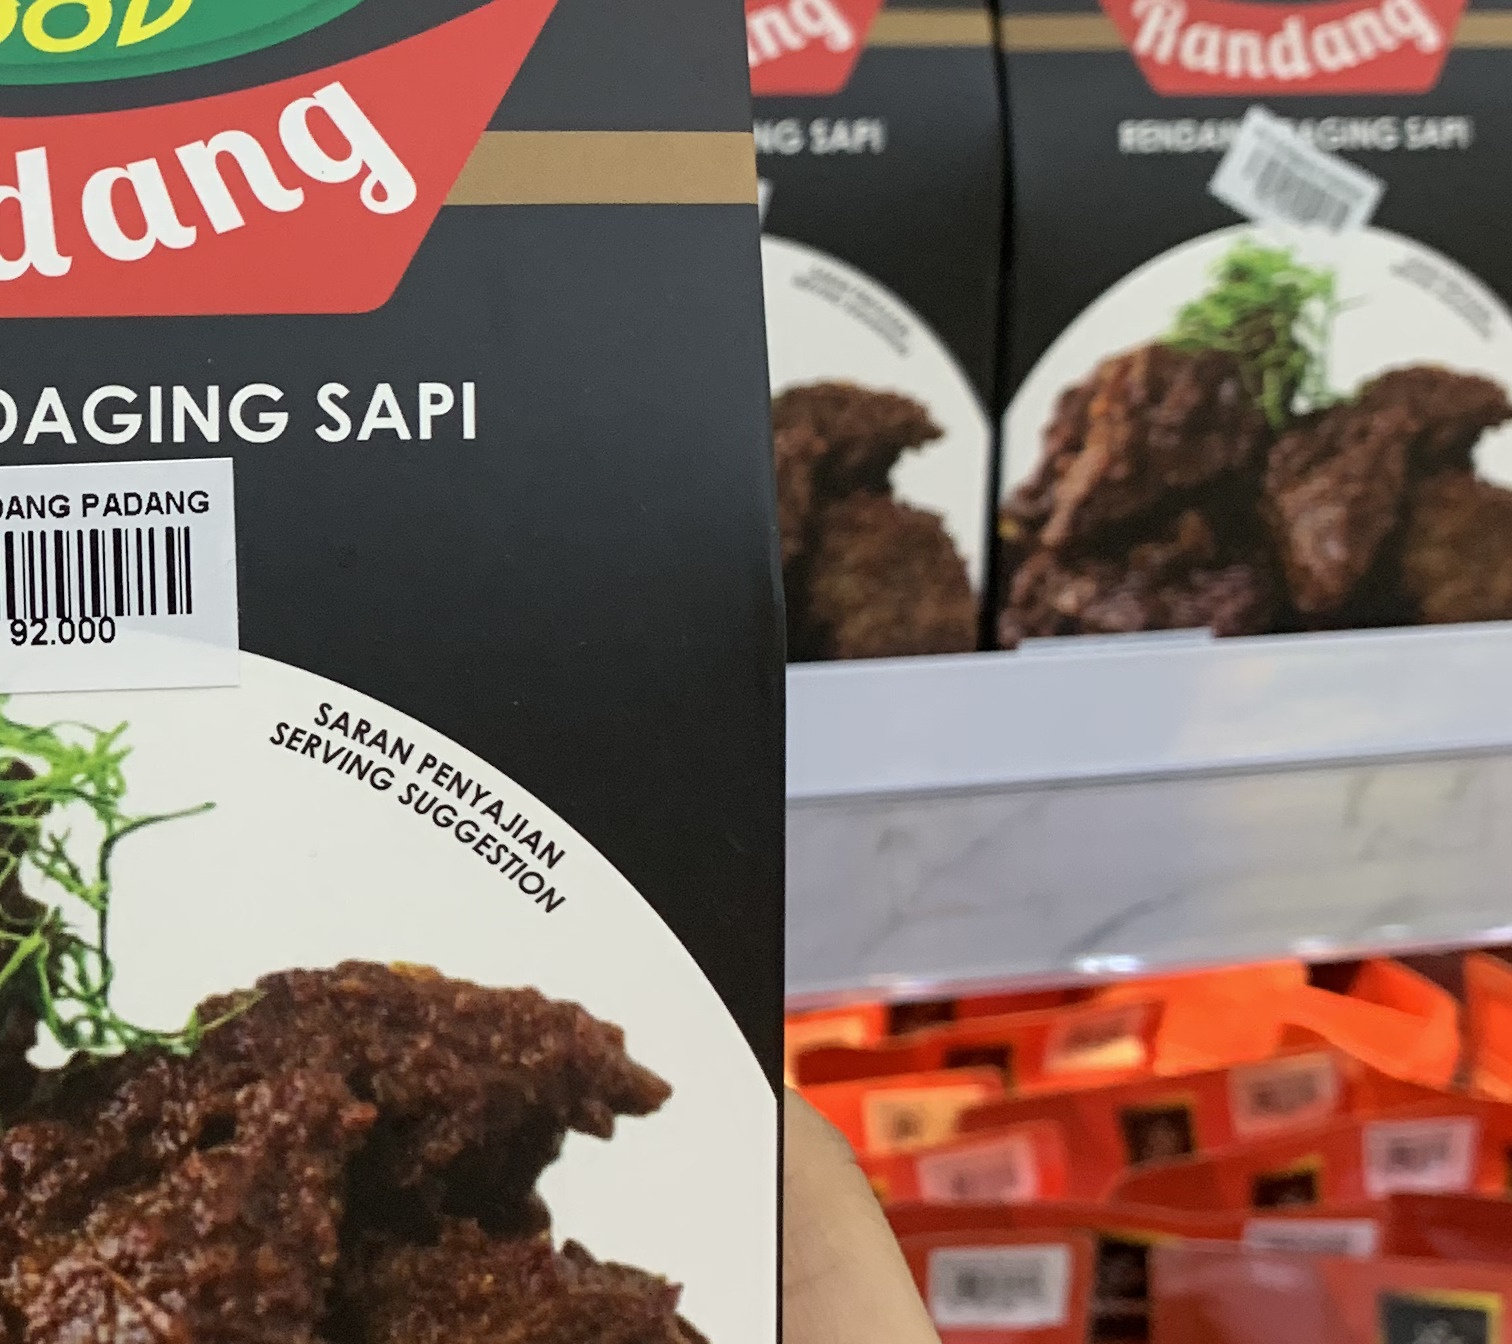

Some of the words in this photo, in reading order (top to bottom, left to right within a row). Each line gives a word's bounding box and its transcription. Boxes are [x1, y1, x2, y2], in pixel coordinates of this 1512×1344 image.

[315, 382, 477, 442] SAPI
[82, 489, 210, 518] PADANG
[10, 617, 116, 646] 92.000
[314, 702, 415, 765] SARAN
[416, 753, 566, 869] PENYAJIAN
[269, 722, 395, 791] SERVING
[398, 783, 567, 913] SUGGESTION
